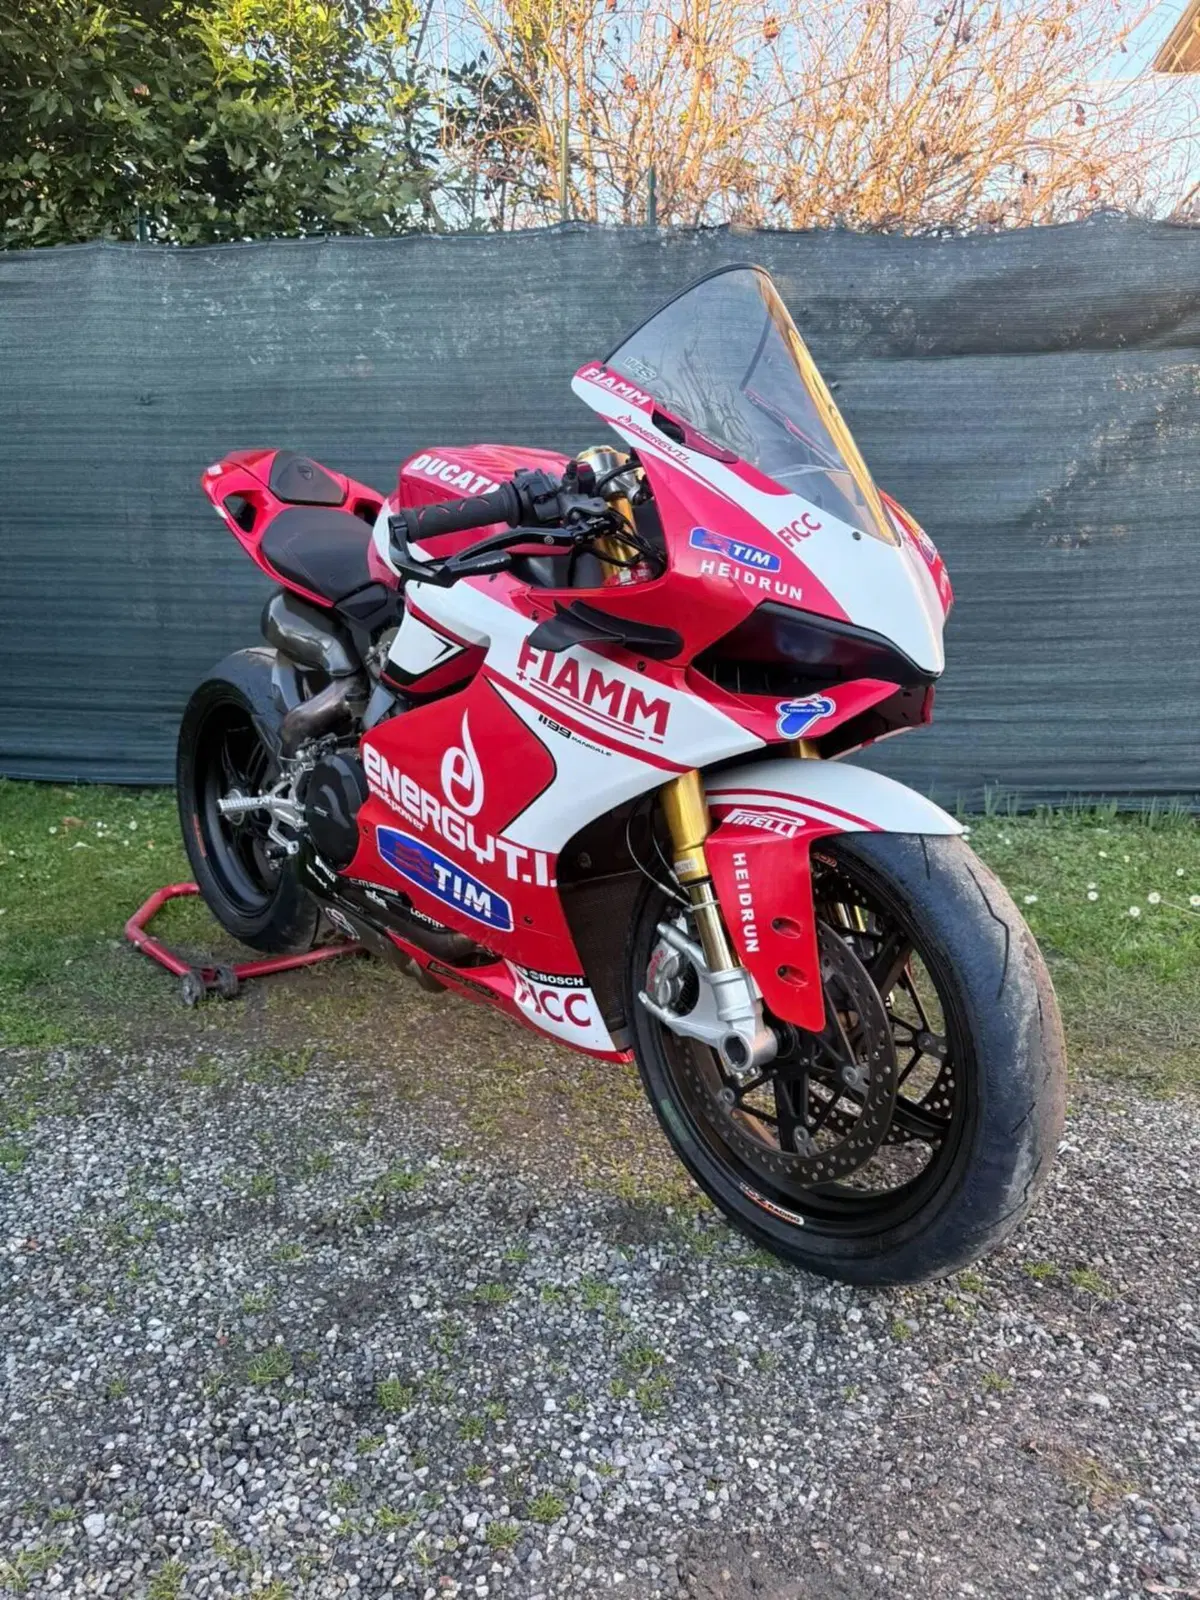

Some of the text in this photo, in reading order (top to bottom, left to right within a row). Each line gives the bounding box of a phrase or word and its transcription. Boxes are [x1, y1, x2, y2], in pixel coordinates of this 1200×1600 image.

[580, 367, 652, 405] FIAMM
[777, 512, 822, 548] FICC
[732, 544, 771, 567] TIM
[700, 559, 803, 601] HEIDRUN
[517, 635, 672, 737] FIAMM
[538, 713, 573, 738] 1199
[722, 807, 806, 839] PIRELLI
[433, 862, 492, 919] TIM
[732, 852, 761, 954] HEIDRUN
[539, 975, 585, 986] BOSCH
